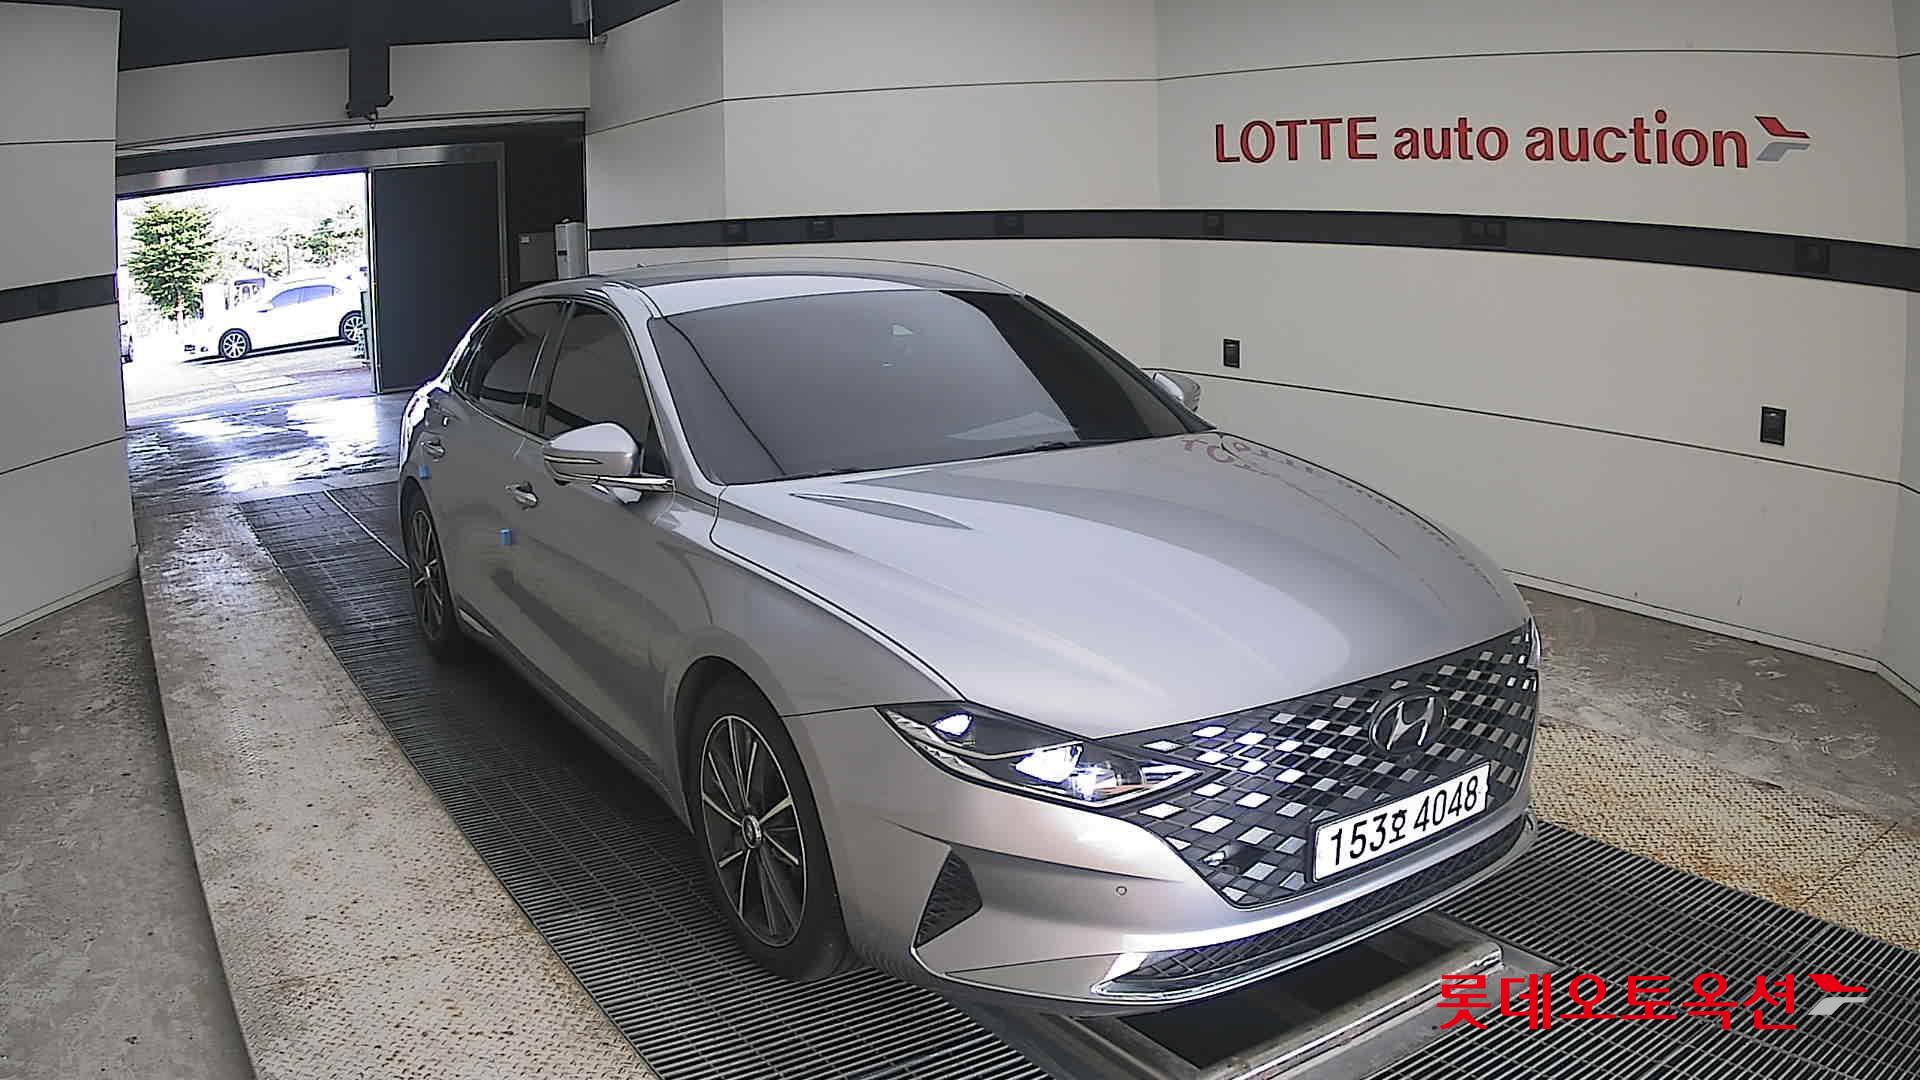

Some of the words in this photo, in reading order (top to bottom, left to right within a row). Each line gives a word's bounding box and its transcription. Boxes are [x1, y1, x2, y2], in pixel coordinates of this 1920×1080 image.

[1216, 116, 1378, 163] LOTTE
[1393, 117, 1509, 161] auto
[1525, 109, 1748, 168] auction
[1413, 774, 1479, 832] 4048
